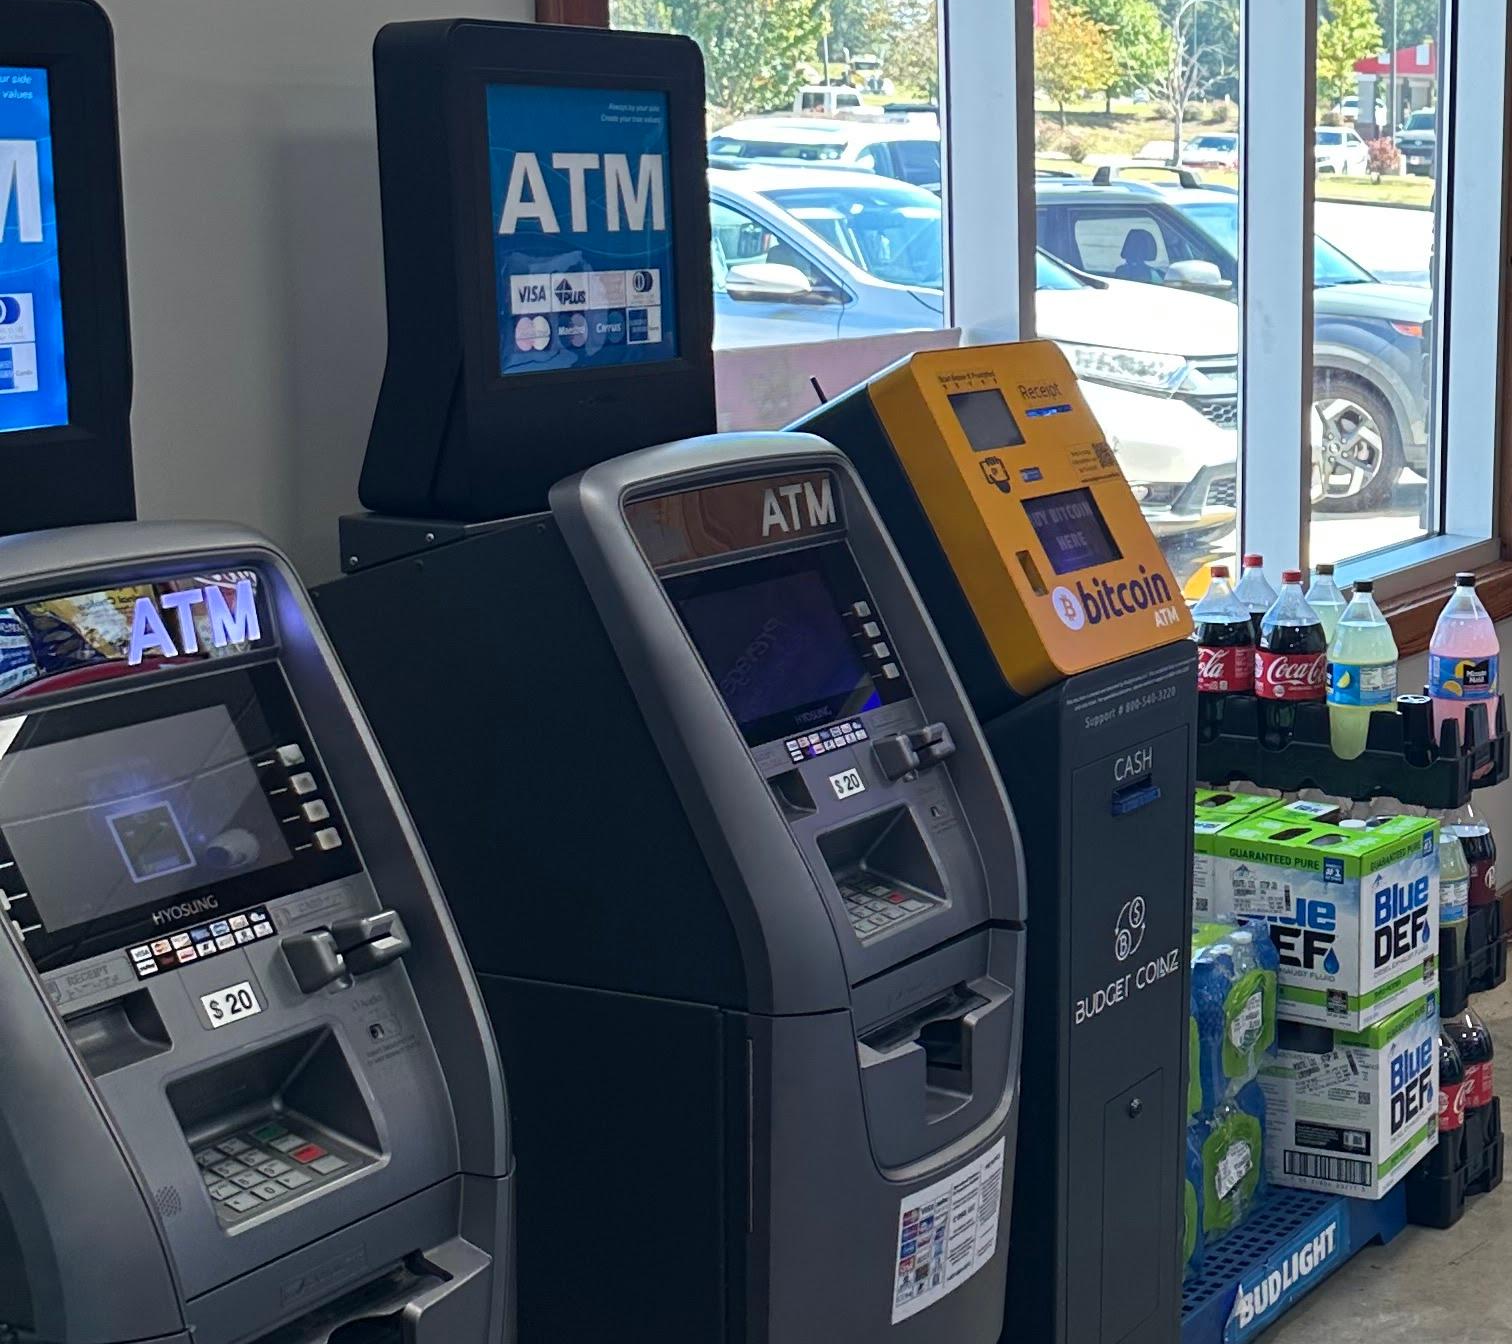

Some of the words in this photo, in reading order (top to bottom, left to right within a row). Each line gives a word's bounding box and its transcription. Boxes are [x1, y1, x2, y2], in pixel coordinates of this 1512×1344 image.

[498, 152, 666, 234] ATM
[519, 285, 546, 303] VISA
[563, 290, 586, 305] PLUS
[596, 322, 622, 334] Cirrus
[1018, 382, 1062, 401] Receipt
[762, 479, 838, 537] ATM
[1056, 532, 1088, 551] HERE
[1077, 565, 1171, 624] bitcoin
[128, 579, 261, 666] ATM
[1154, 606, 1180, 628] ATM
[1084, 708, 1116, 728] Support
[1114, 746, 1153, 781] CASH
[834, 778, 844, 795] $
[845, 773, 861, 791] 20
[1229, 847, 1292, 866] GUARANTEED
[1294, 855, 1320, 870] PURE
[151, 894, 219, 926] HYOSUNG
[1375, 875, 1429, 928] Blue
[1269, 925, 1336, 969] EF
[1374, 905, 1429, 969] DEF
[1075, 974, 1131, 1025] BUDGET
[1136, 948, 1180, 990] COINZ
[208, 1001, 224, 1021] $
[225, 988, 254, 1015] 20
[1391, 1036, 1433, 1096] Blue
[1391, 1064, 1433, 1135] DEF
[1239, 1270, 1283, 1329] BUD
[1283, 1222, 1336, 1292] LIGHT
